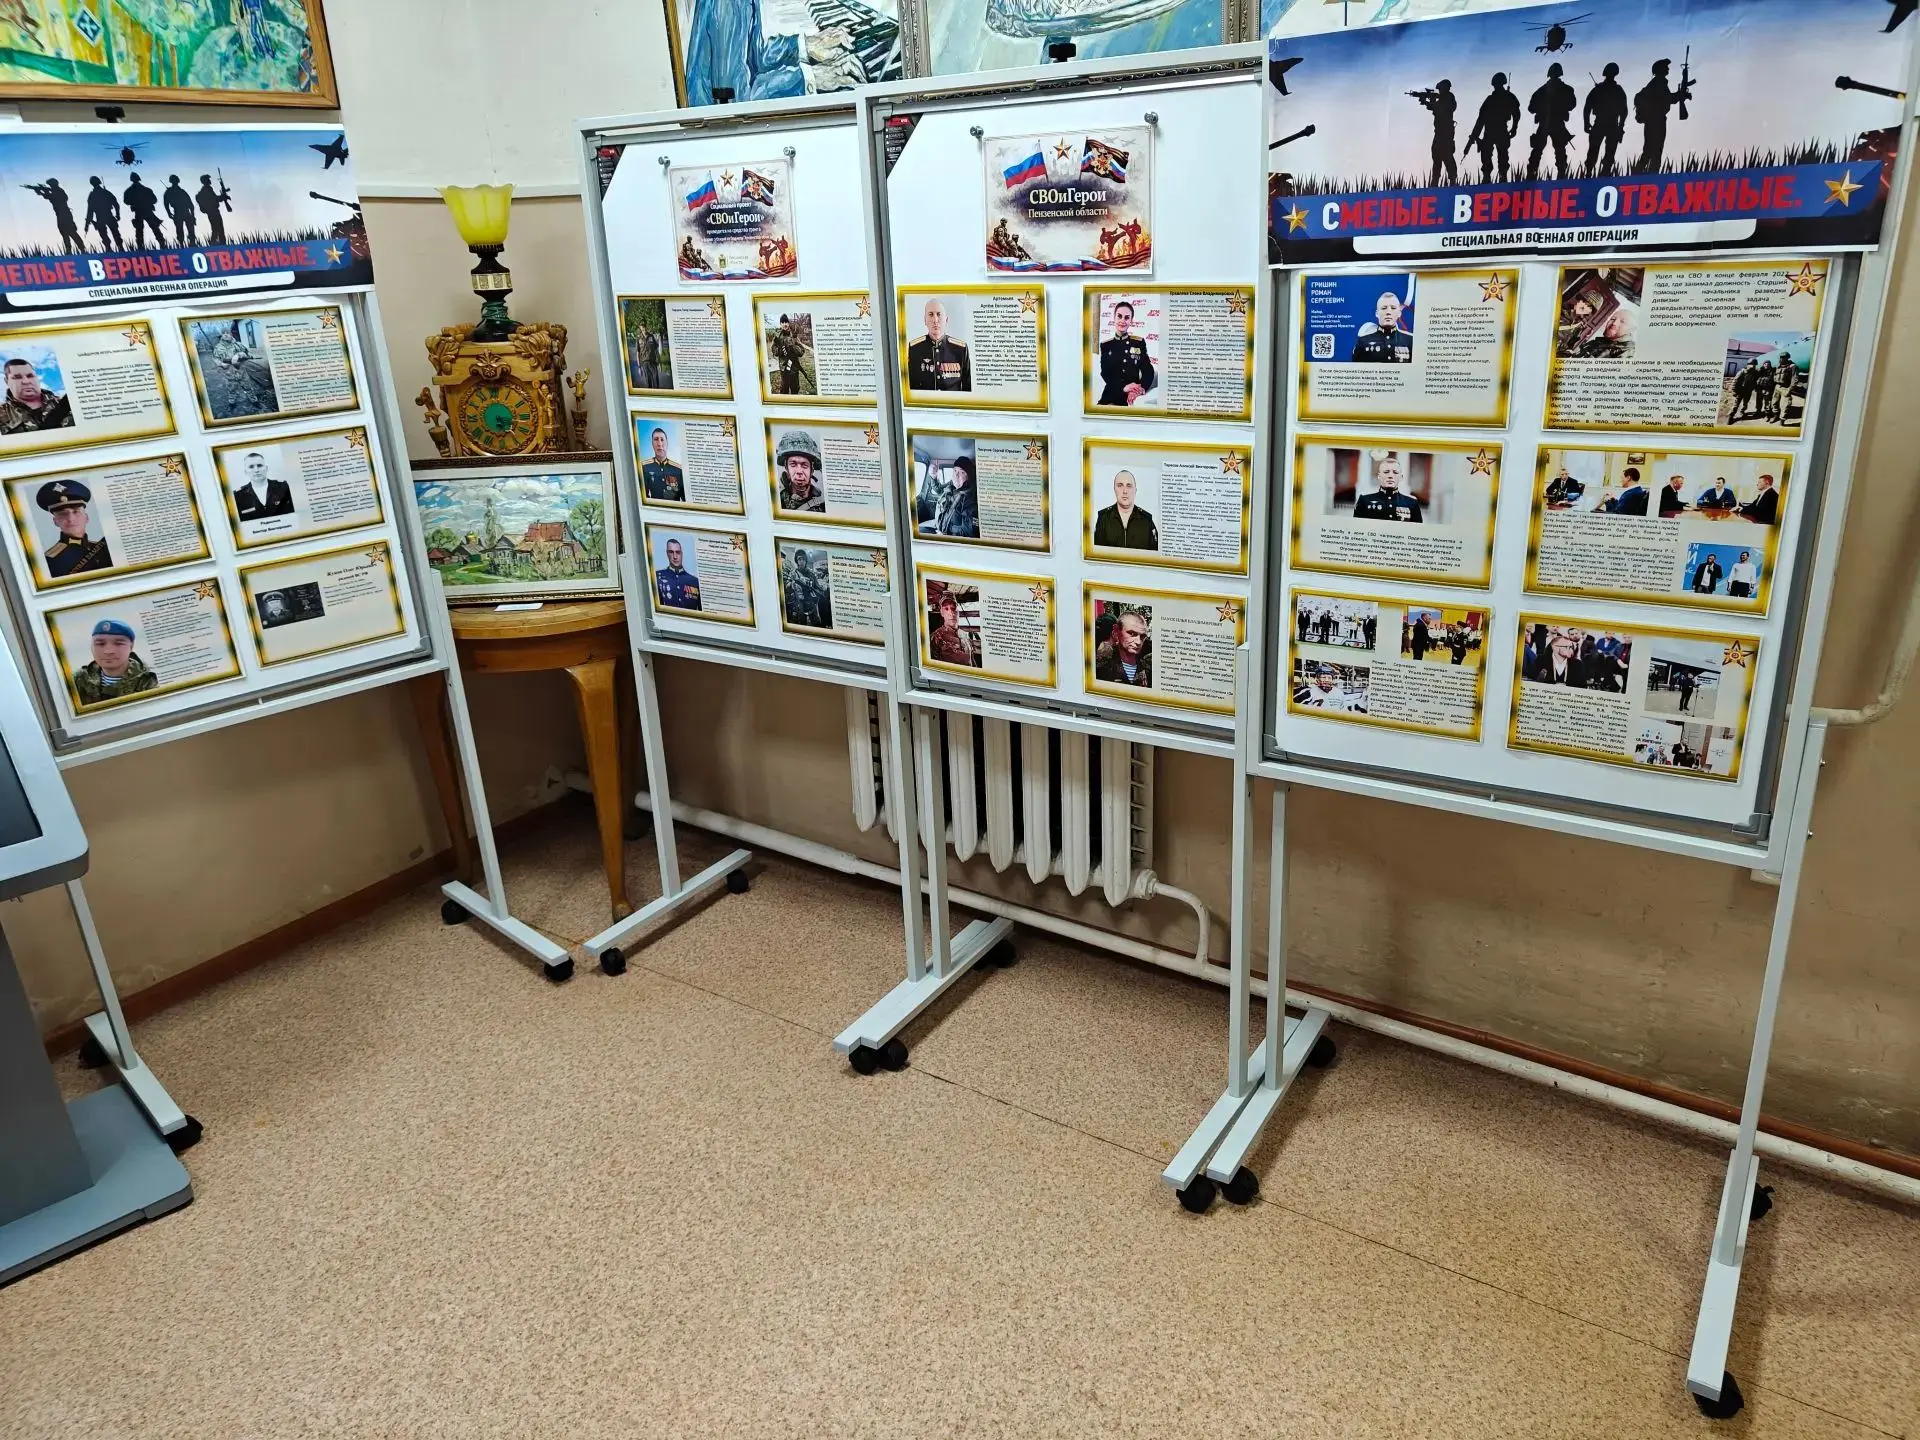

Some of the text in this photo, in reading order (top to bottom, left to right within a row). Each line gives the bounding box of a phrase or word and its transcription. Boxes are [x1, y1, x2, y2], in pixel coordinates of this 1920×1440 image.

[1030, 188, 1106, 205] СВОиГерои
[1322, 176, 1802, 231] СМЕЛЫЕ. ВЕРНЫЕ. ОТВАЖНЫЕ.
[1029, 207, 1108, 218] Пензенской области
[1442, 229, 1638, 248] СПЕЦИАЛЬНАЯ ВОЕННАЯ ОПЕРАЦИЯ
[88, 254, 188, 281] ВЕРНЫЕ.
[192, 246, 316, 274] ОТВАЖНЫЕ.
[88, 279, 228, 298] СПЕЦИАЛЬНАЯ ВОЕННАЯ ОПЕРАЦИЯ
